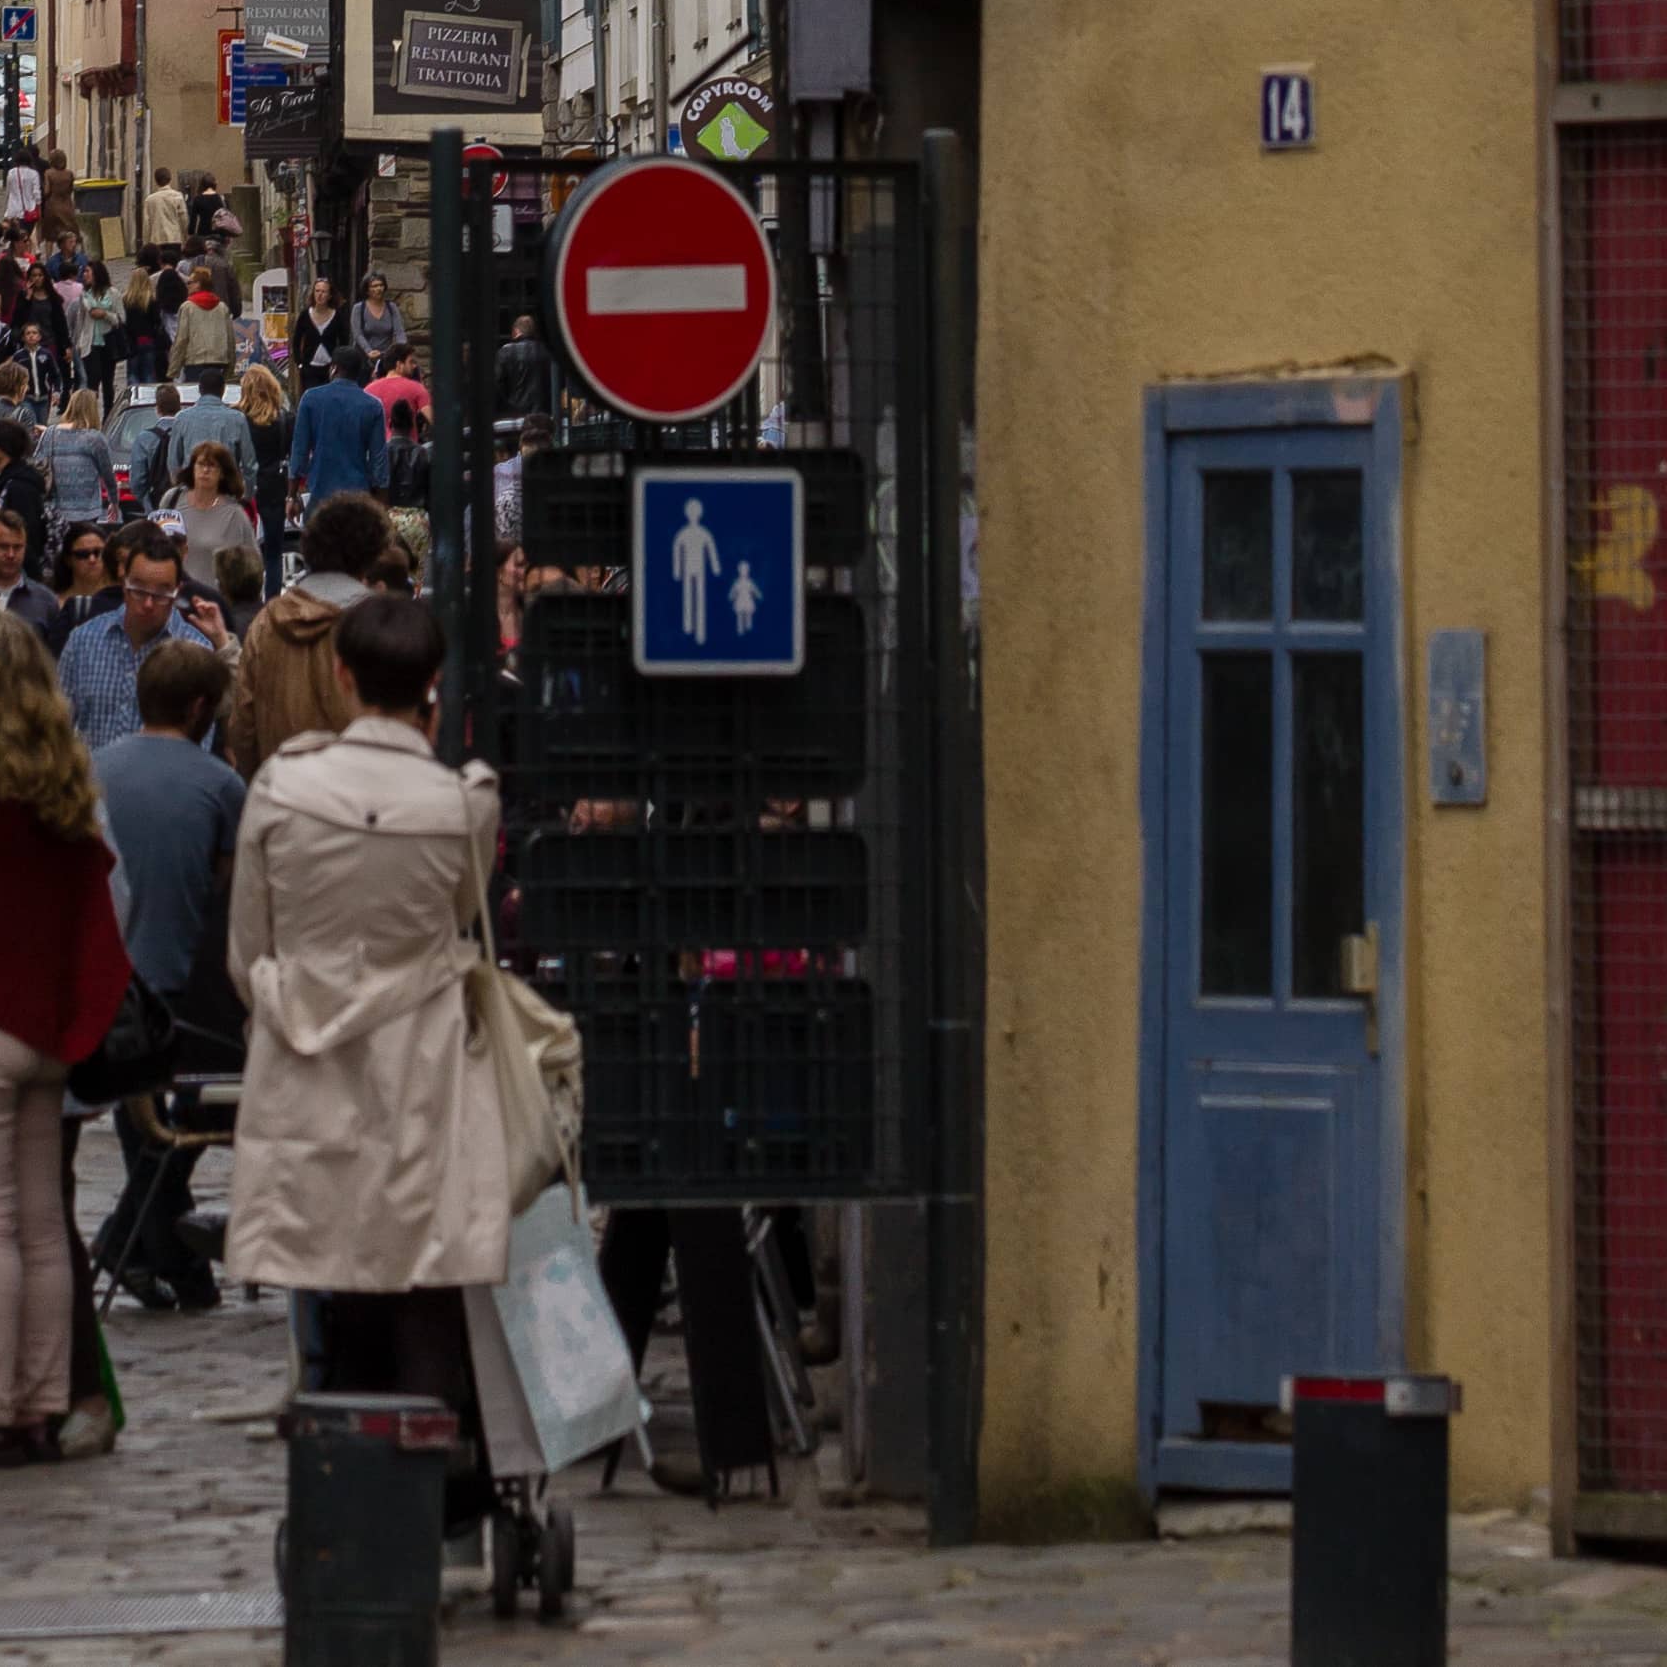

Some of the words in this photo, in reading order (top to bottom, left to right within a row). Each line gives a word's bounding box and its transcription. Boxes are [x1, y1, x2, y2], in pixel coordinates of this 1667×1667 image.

[246, 7, 329, 19] RESTAURANT
[250, 24, 325, 37] TRATTORIA
[428, 26, 498, 46] PIZZERIA
[411, 46, 510, 68] RESTAURANT
[416, 67, 502, 88] TRATTORIA
[686, 81, 774, 121] COPYROOM
[1268, 77, 1305, 141] 14
